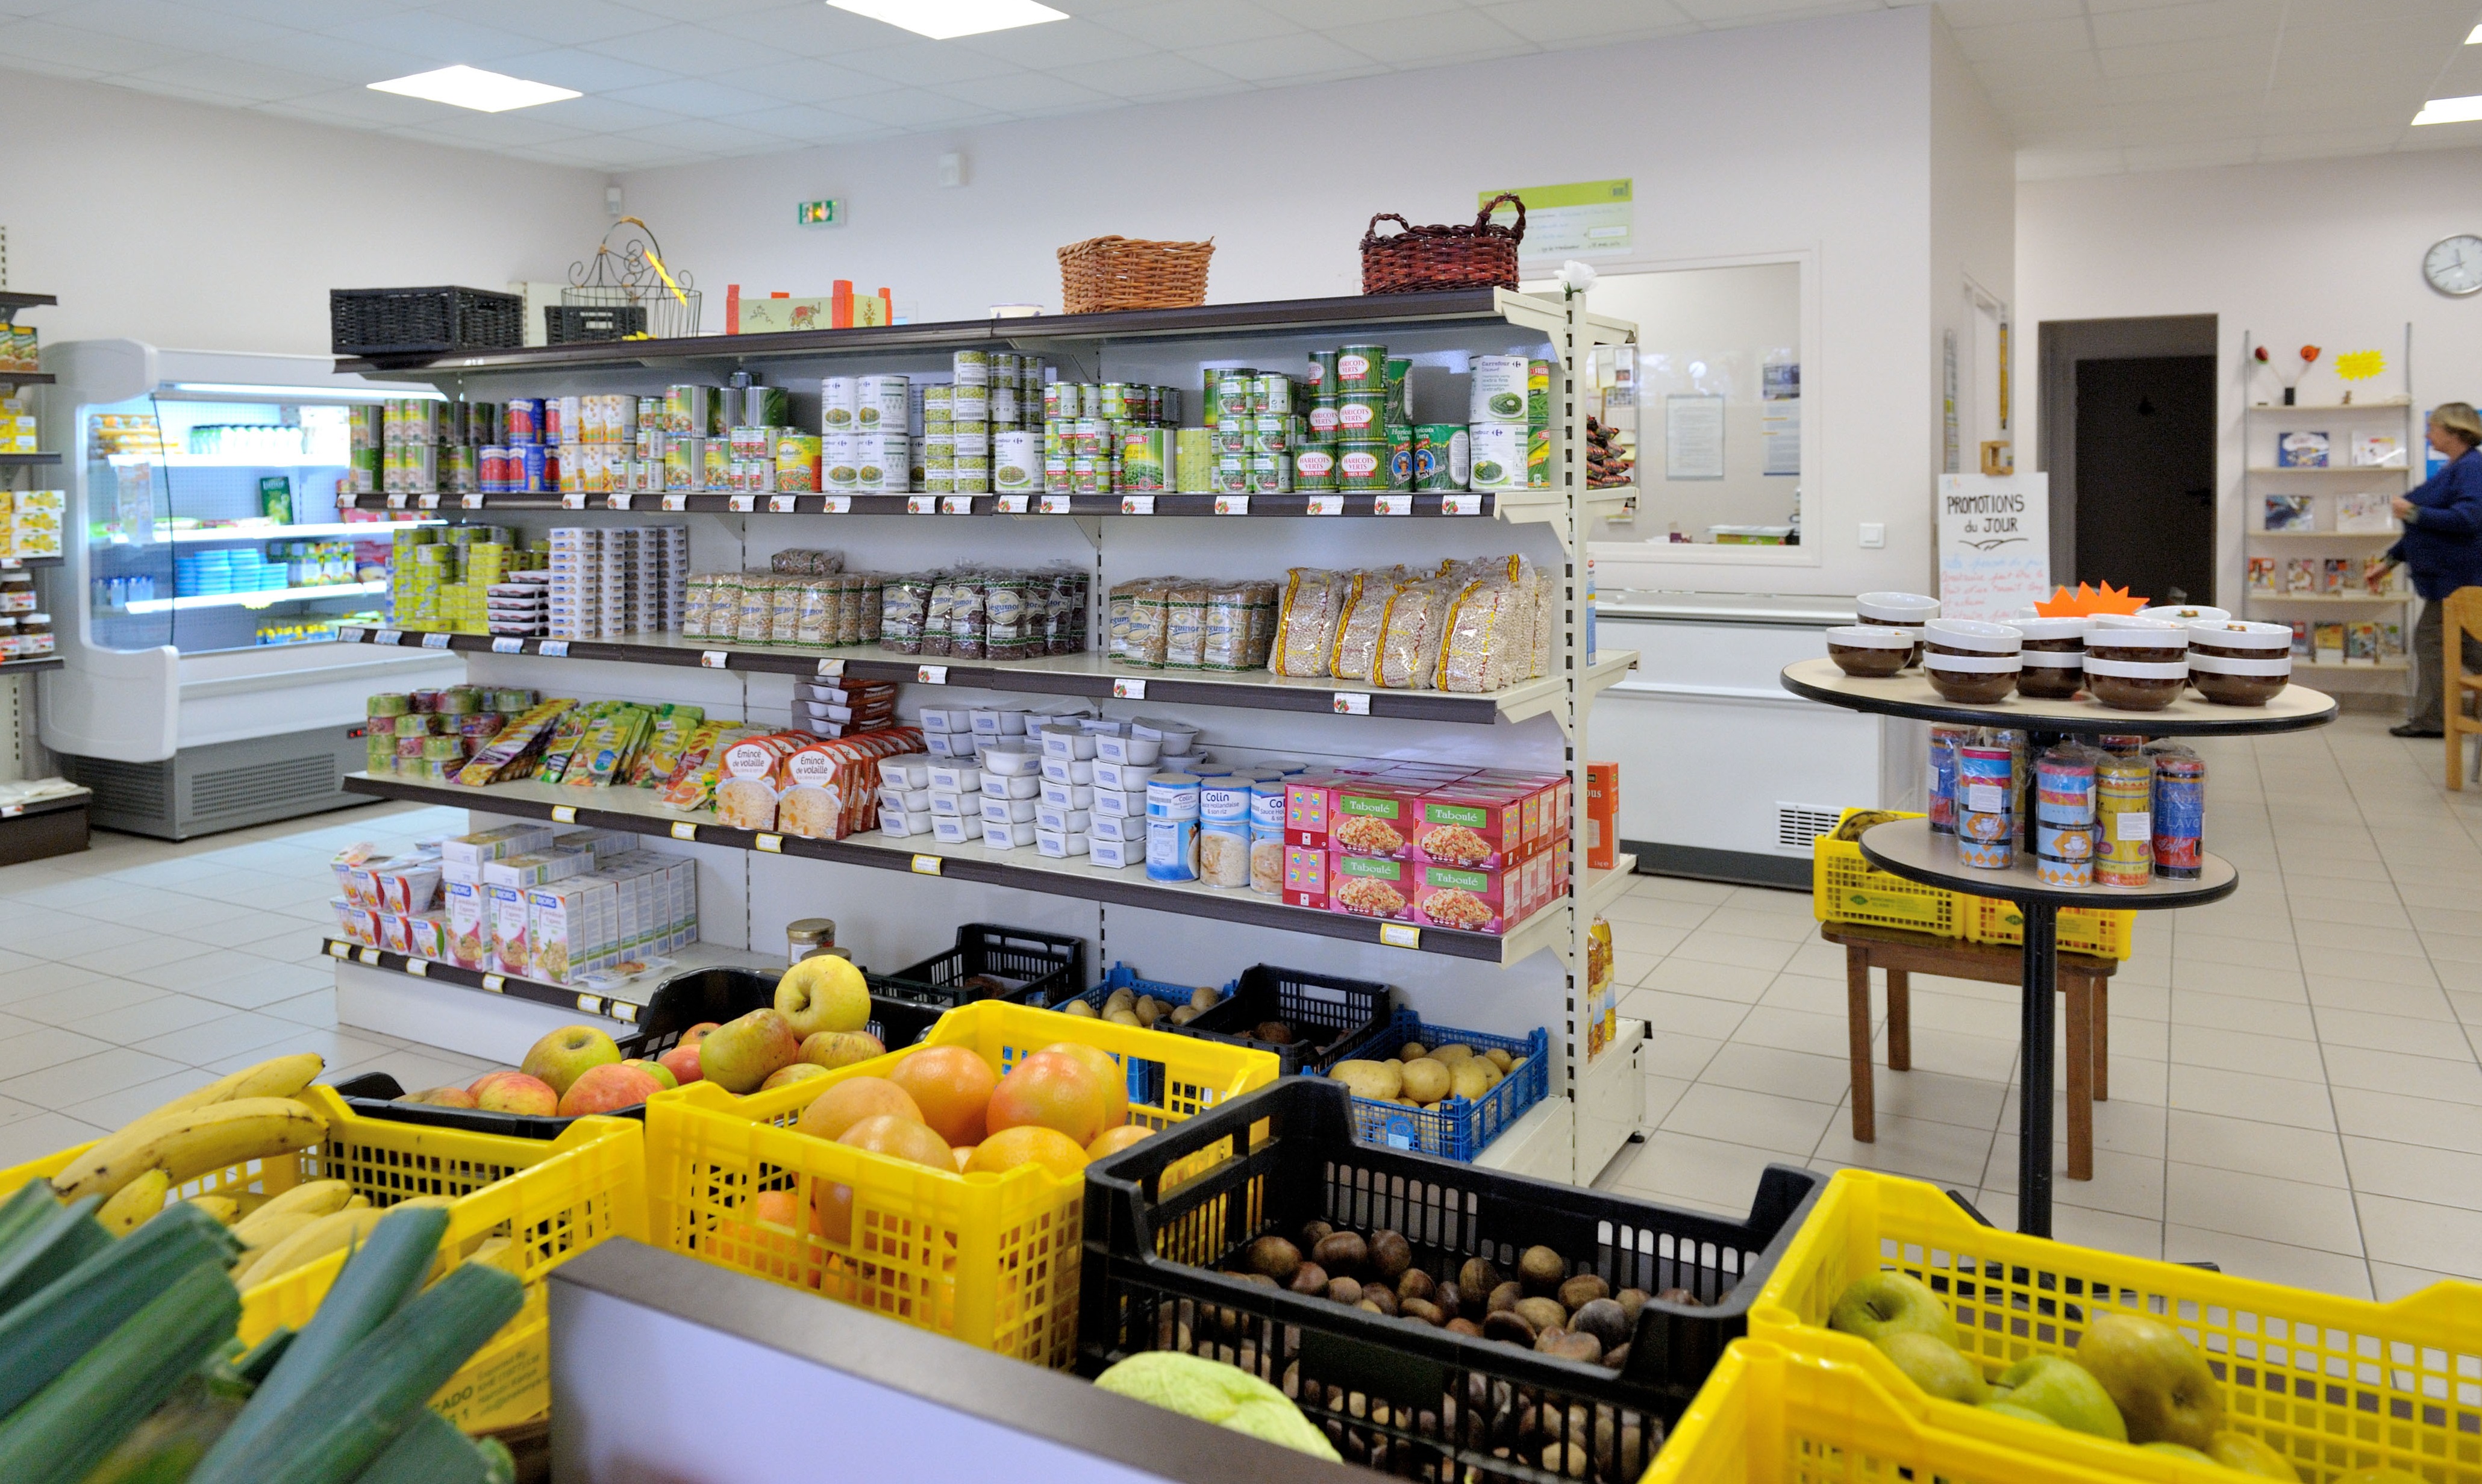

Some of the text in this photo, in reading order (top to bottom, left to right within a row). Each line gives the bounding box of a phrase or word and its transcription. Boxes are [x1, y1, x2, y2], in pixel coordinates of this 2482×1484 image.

[1947, 494, 2025, 514] PROMOTIONS
[1965, 517, 2018, 533] du JOUR
[988, 603, 1020, 613] légumor
[737, 747, 761, 758] Émincé
[801, 755, 825, 765] Émincé
[804, 765, 828, 774] volaille
[1205, 793, 1230, 802] Colin
[1350, 800, 1390, 813] Taboulé
[1436, 809, 1478, 822] Taboulé
[1351, 862, 1392, 874] Taboulé
[1436, 873, 1479, 886] Taboulé
